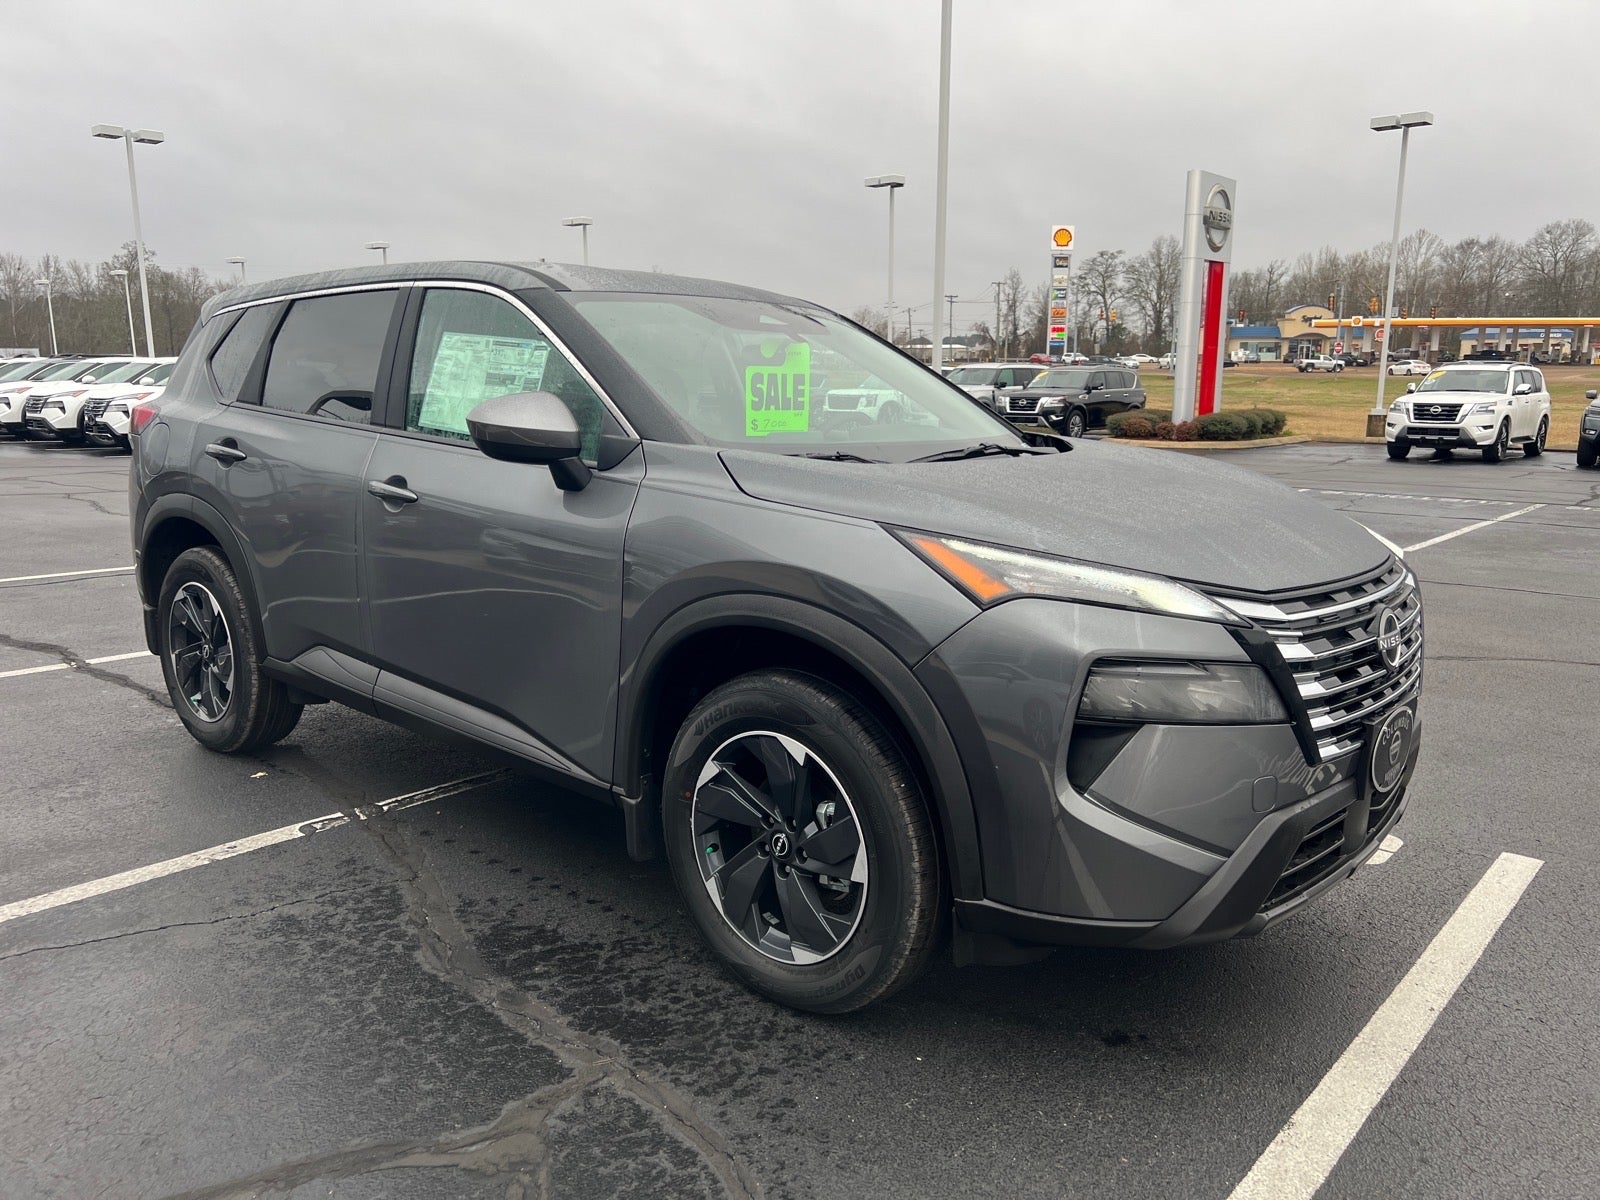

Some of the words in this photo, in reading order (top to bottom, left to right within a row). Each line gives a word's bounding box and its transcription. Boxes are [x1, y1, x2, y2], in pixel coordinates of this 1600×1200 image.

[1208, 210, 1230, 223] NISS
[750, 372, 806, 412] SALE
[1380, 635, 1400, 649] NISS
